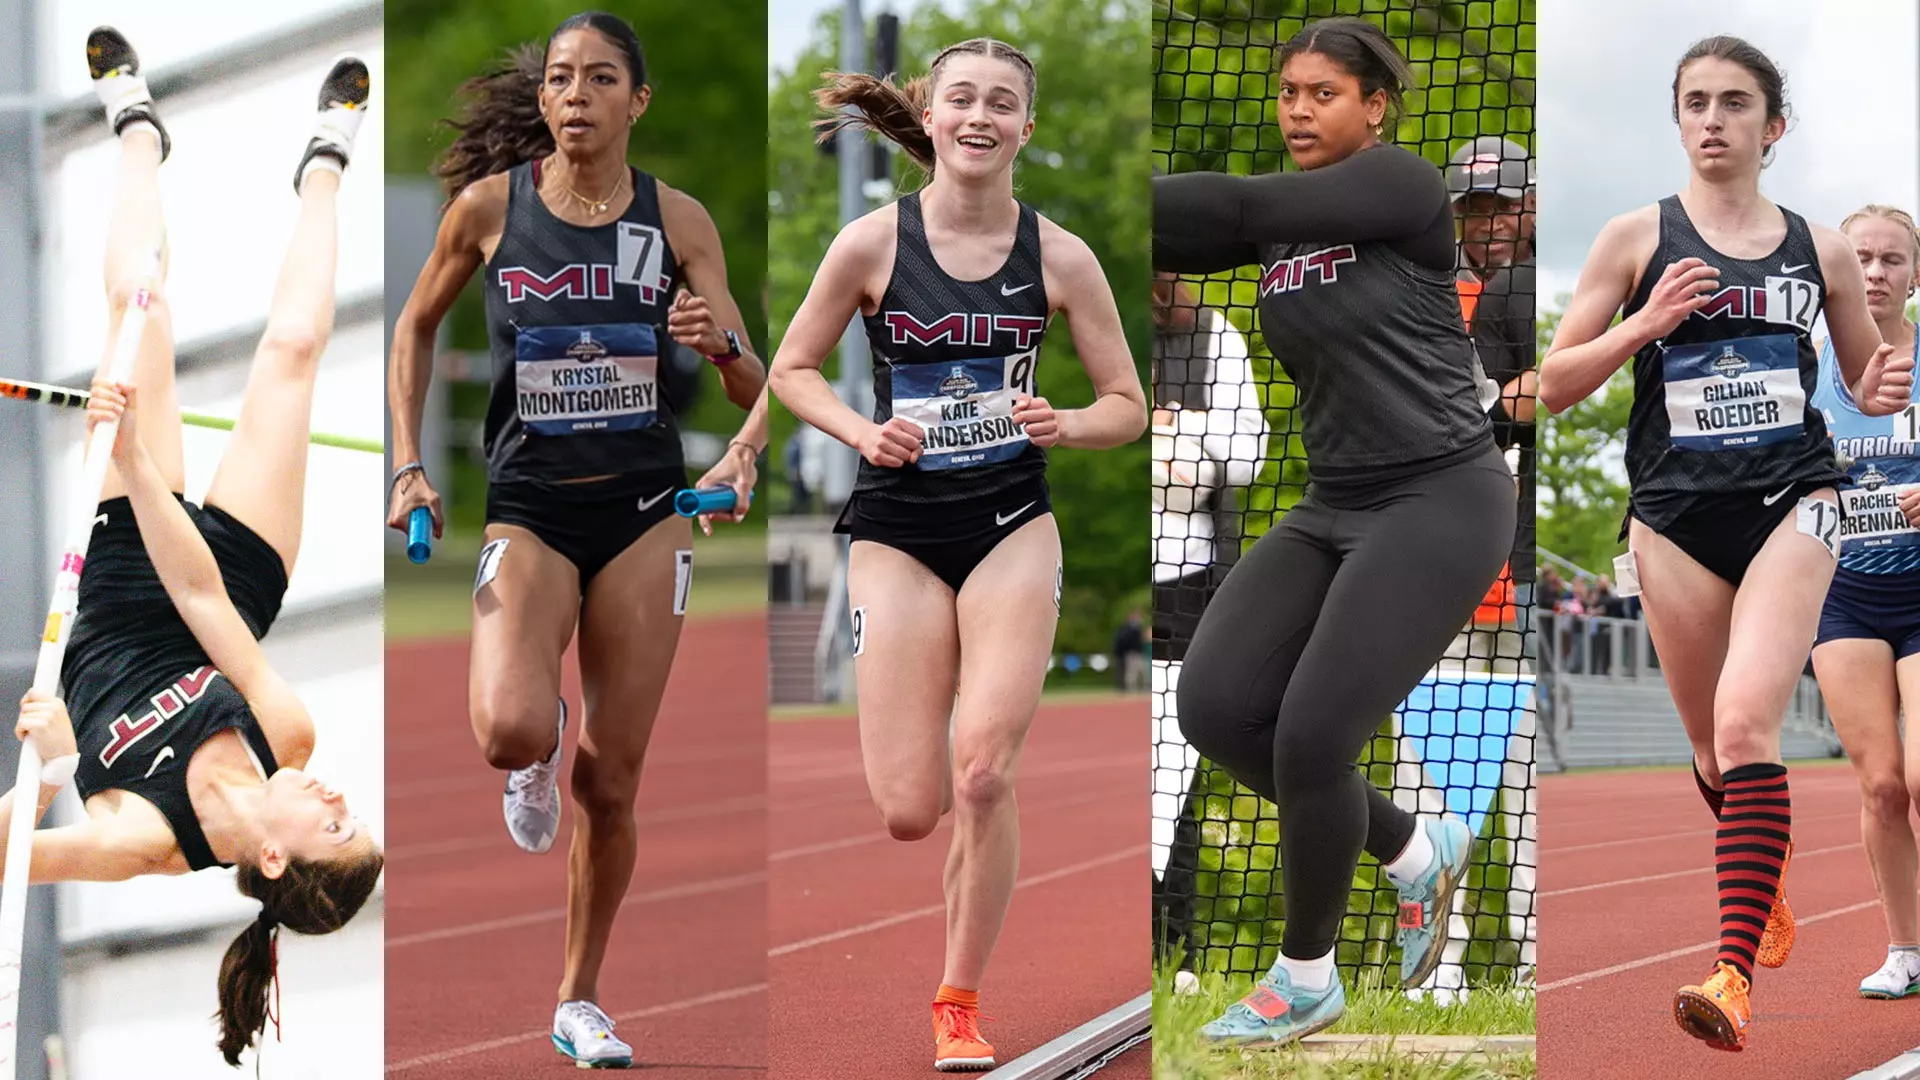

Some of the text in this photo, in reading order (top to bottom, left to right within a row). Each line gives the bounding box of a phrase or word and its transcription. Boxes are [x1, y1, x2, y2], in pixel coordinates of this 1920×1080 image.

[628, 227, 654, 281] 7
[1778, 280, 1811, 328] 12
[885, 311, 1045, 350] MIT
[552, 364, 622, 387] KRYSTAL
[1010, 355, 1032, 406] 9
[1702, 380, 1768, 403] GILLIAN
[519, 382, 654, 416] MONTGOMERY
[940, 400, 979, 421] KATE
[1694, 399, 1780, 431] ROEDER
[1836, 434, 1916, 459] GORDON
[1850, 492, 1900, 512] RACHEL
[1808, 501, 1838, 551] 12
[476, 542, 499, 589] 7
[681, 554, 692, 611] 7
[853, 610, 862, 654] 9
